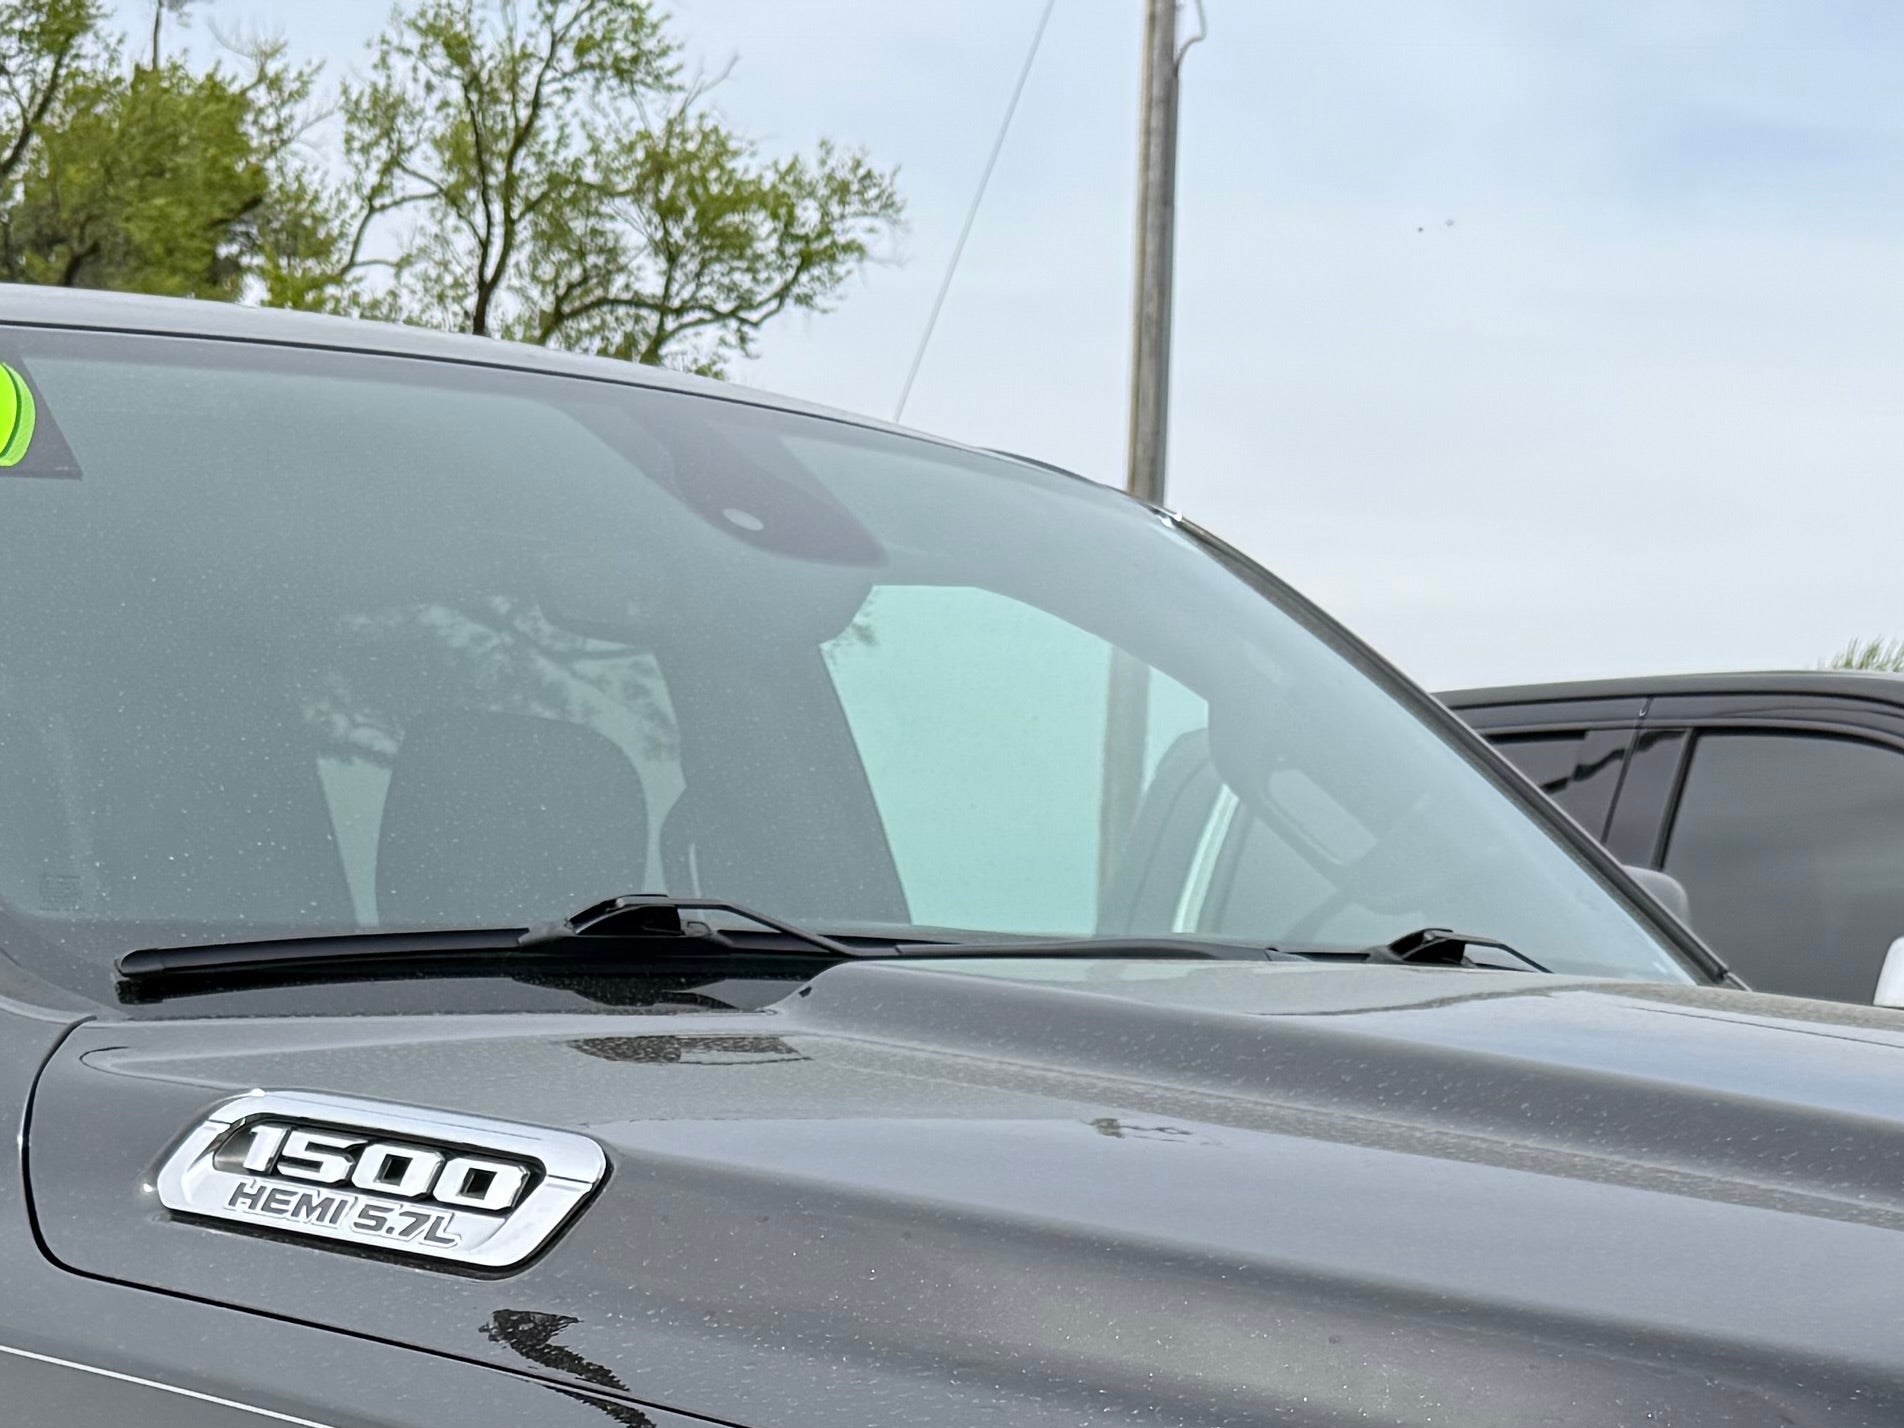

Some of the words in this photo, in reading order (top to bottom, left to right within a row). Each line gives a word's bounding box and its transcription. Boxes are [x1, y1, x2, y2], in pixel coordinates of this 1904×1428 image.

[242, 1124, 530, 1212] 1500
[226, 1181, 350, 1231] HEMI
[352, 1205, 462, 1249] 5.7L
